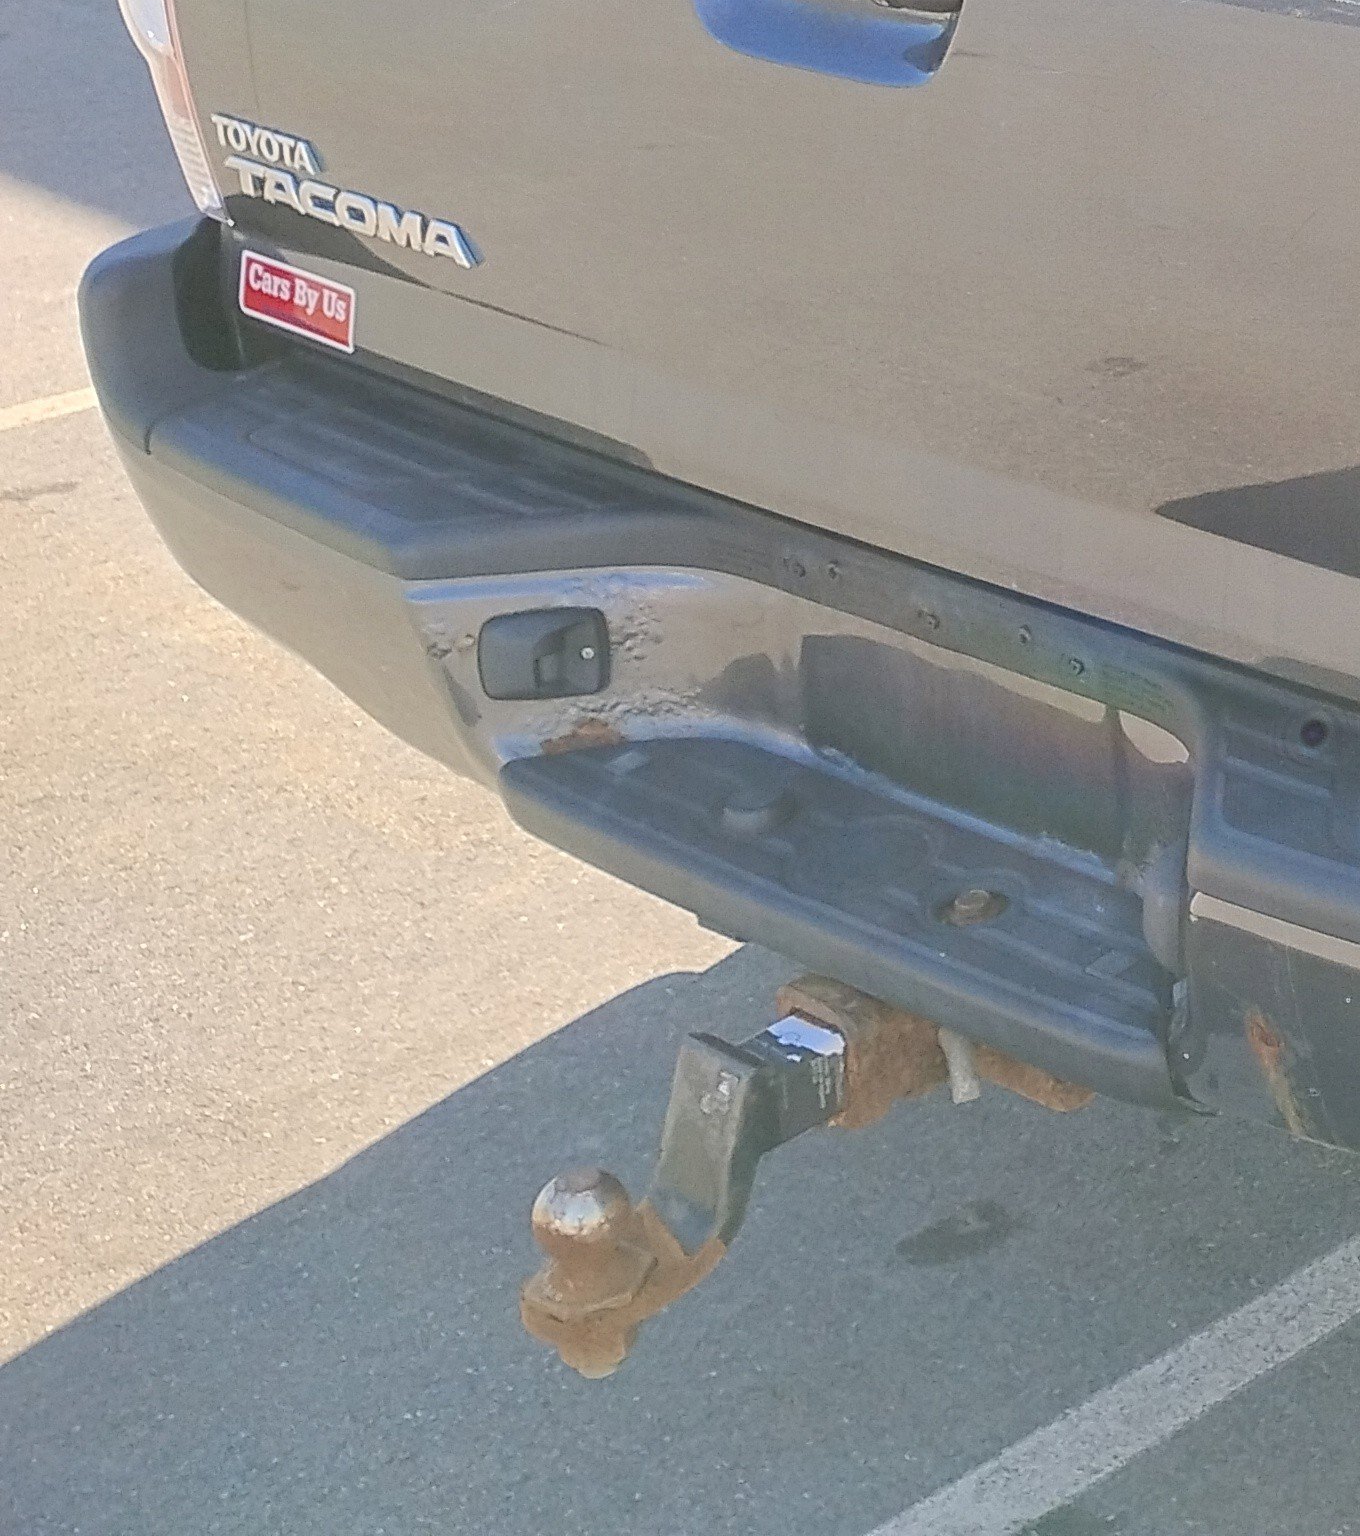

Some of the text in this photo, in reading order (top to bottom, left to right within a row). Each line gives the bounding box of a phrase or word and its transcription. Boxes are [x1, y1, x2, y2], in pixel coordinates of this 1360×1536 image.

[211, 113, 322, 175] TOYOTA
[225, 154, 481, 269] TACOMA
[249, 262, 346, 322] Cars By Us
